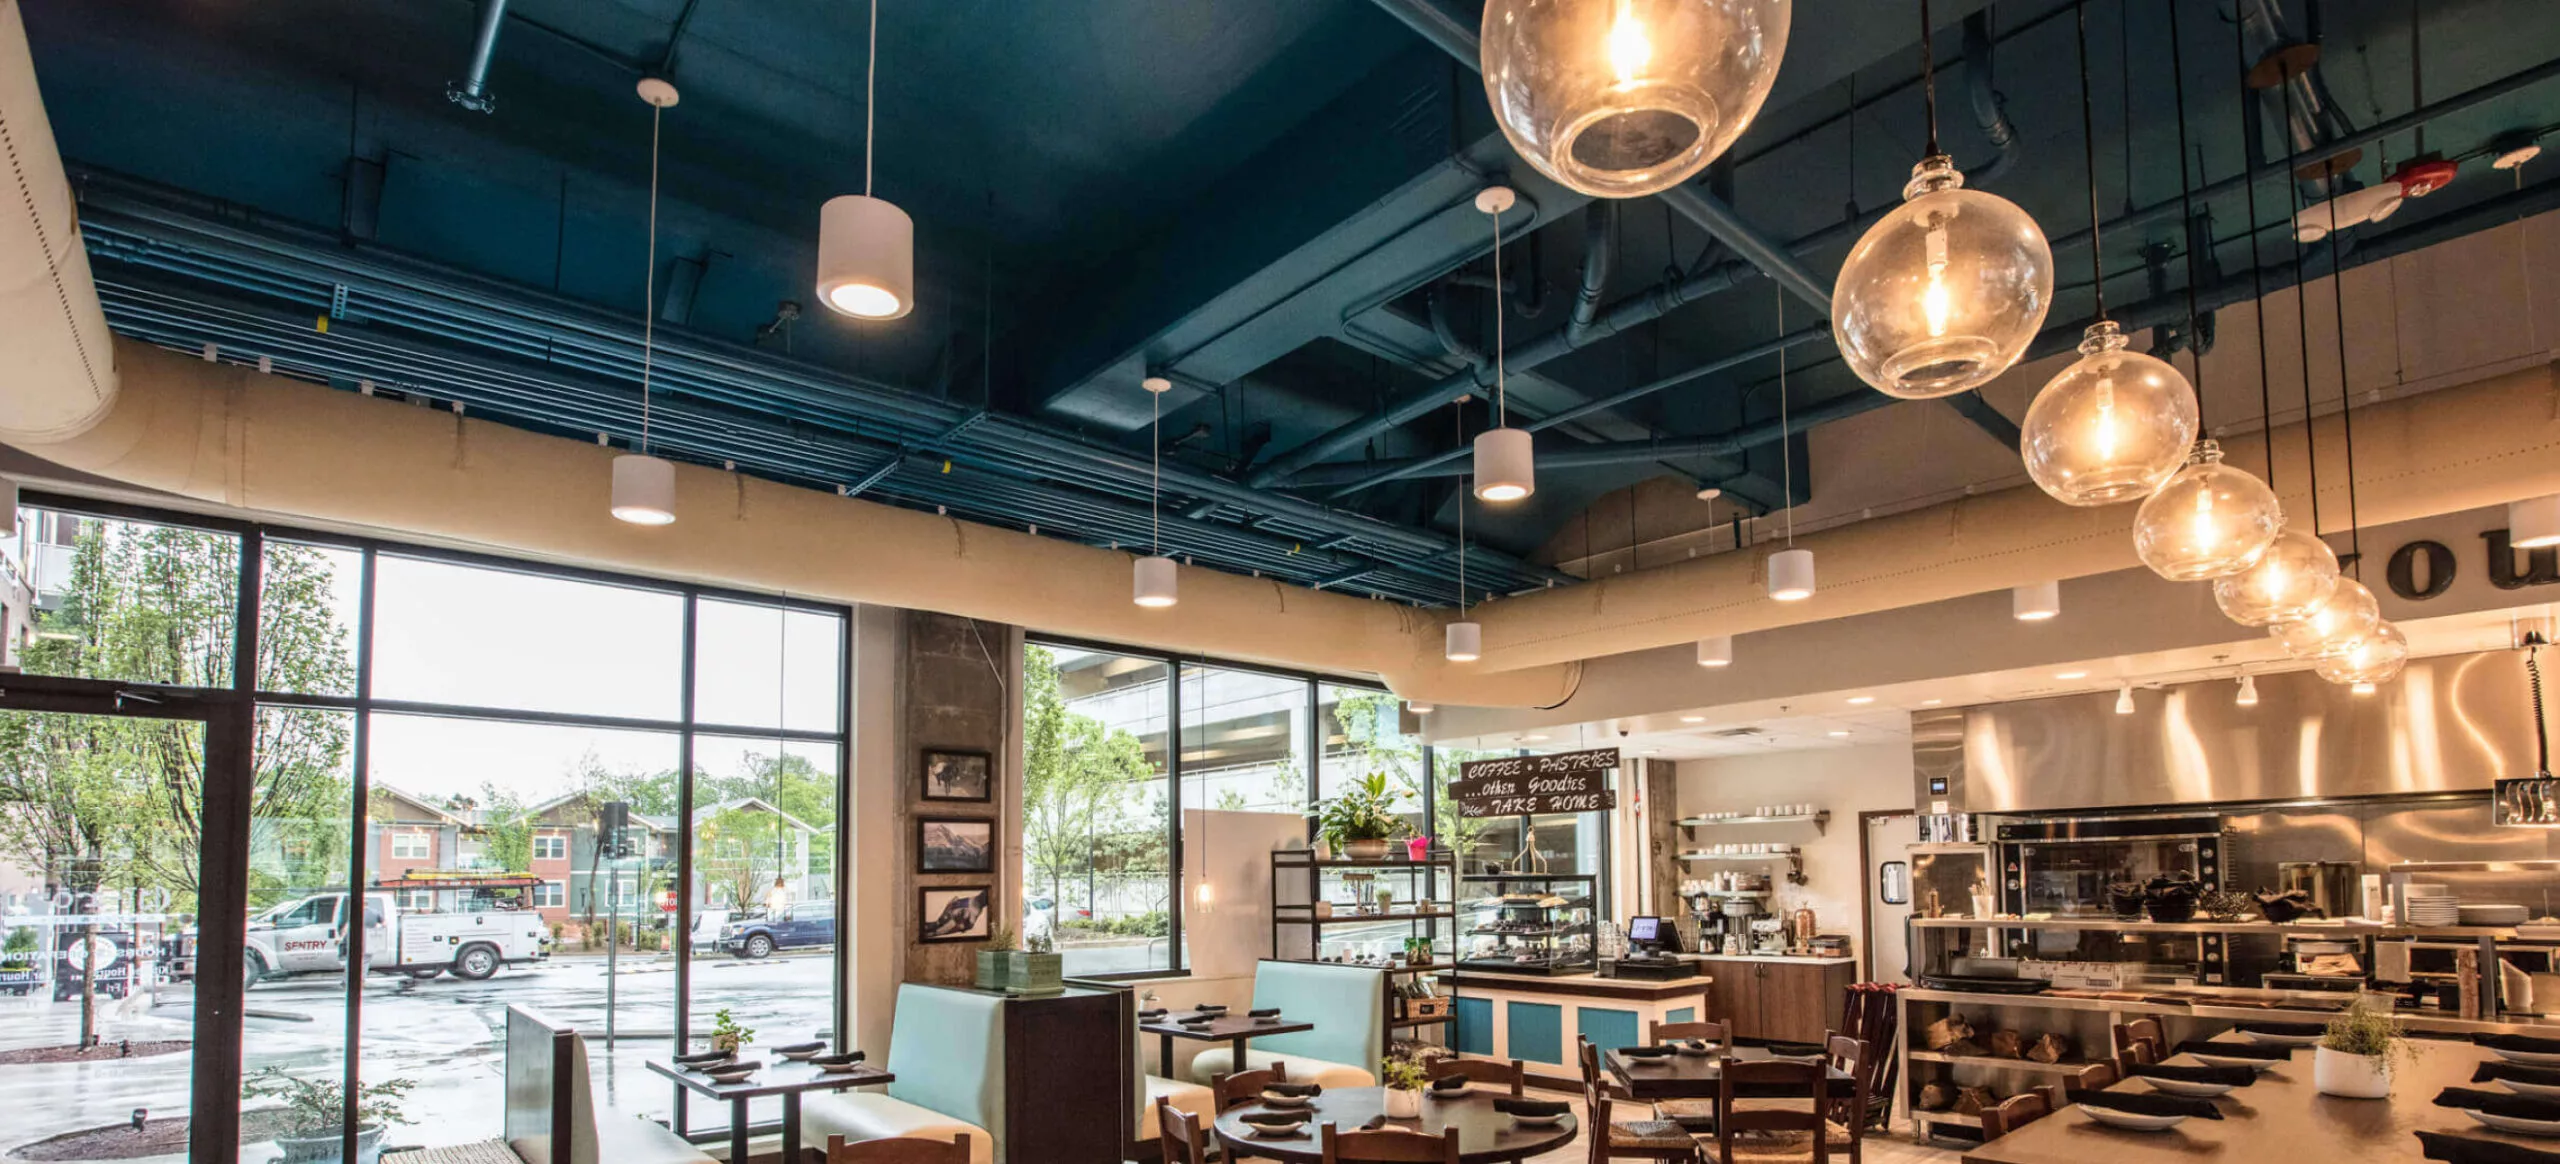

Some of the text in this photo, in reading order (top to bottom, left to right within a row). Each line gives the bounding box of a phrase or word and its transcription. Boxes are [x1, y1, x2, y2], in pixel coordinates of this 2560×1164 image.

[1468, 751, 1615, 779] COFFEE PASTRIES
[1528, 773, 1586, 794] Goodies
[1491, 794, 1599, 815] TAKE HOME
[284, 940, 327, 951] SENTRY
